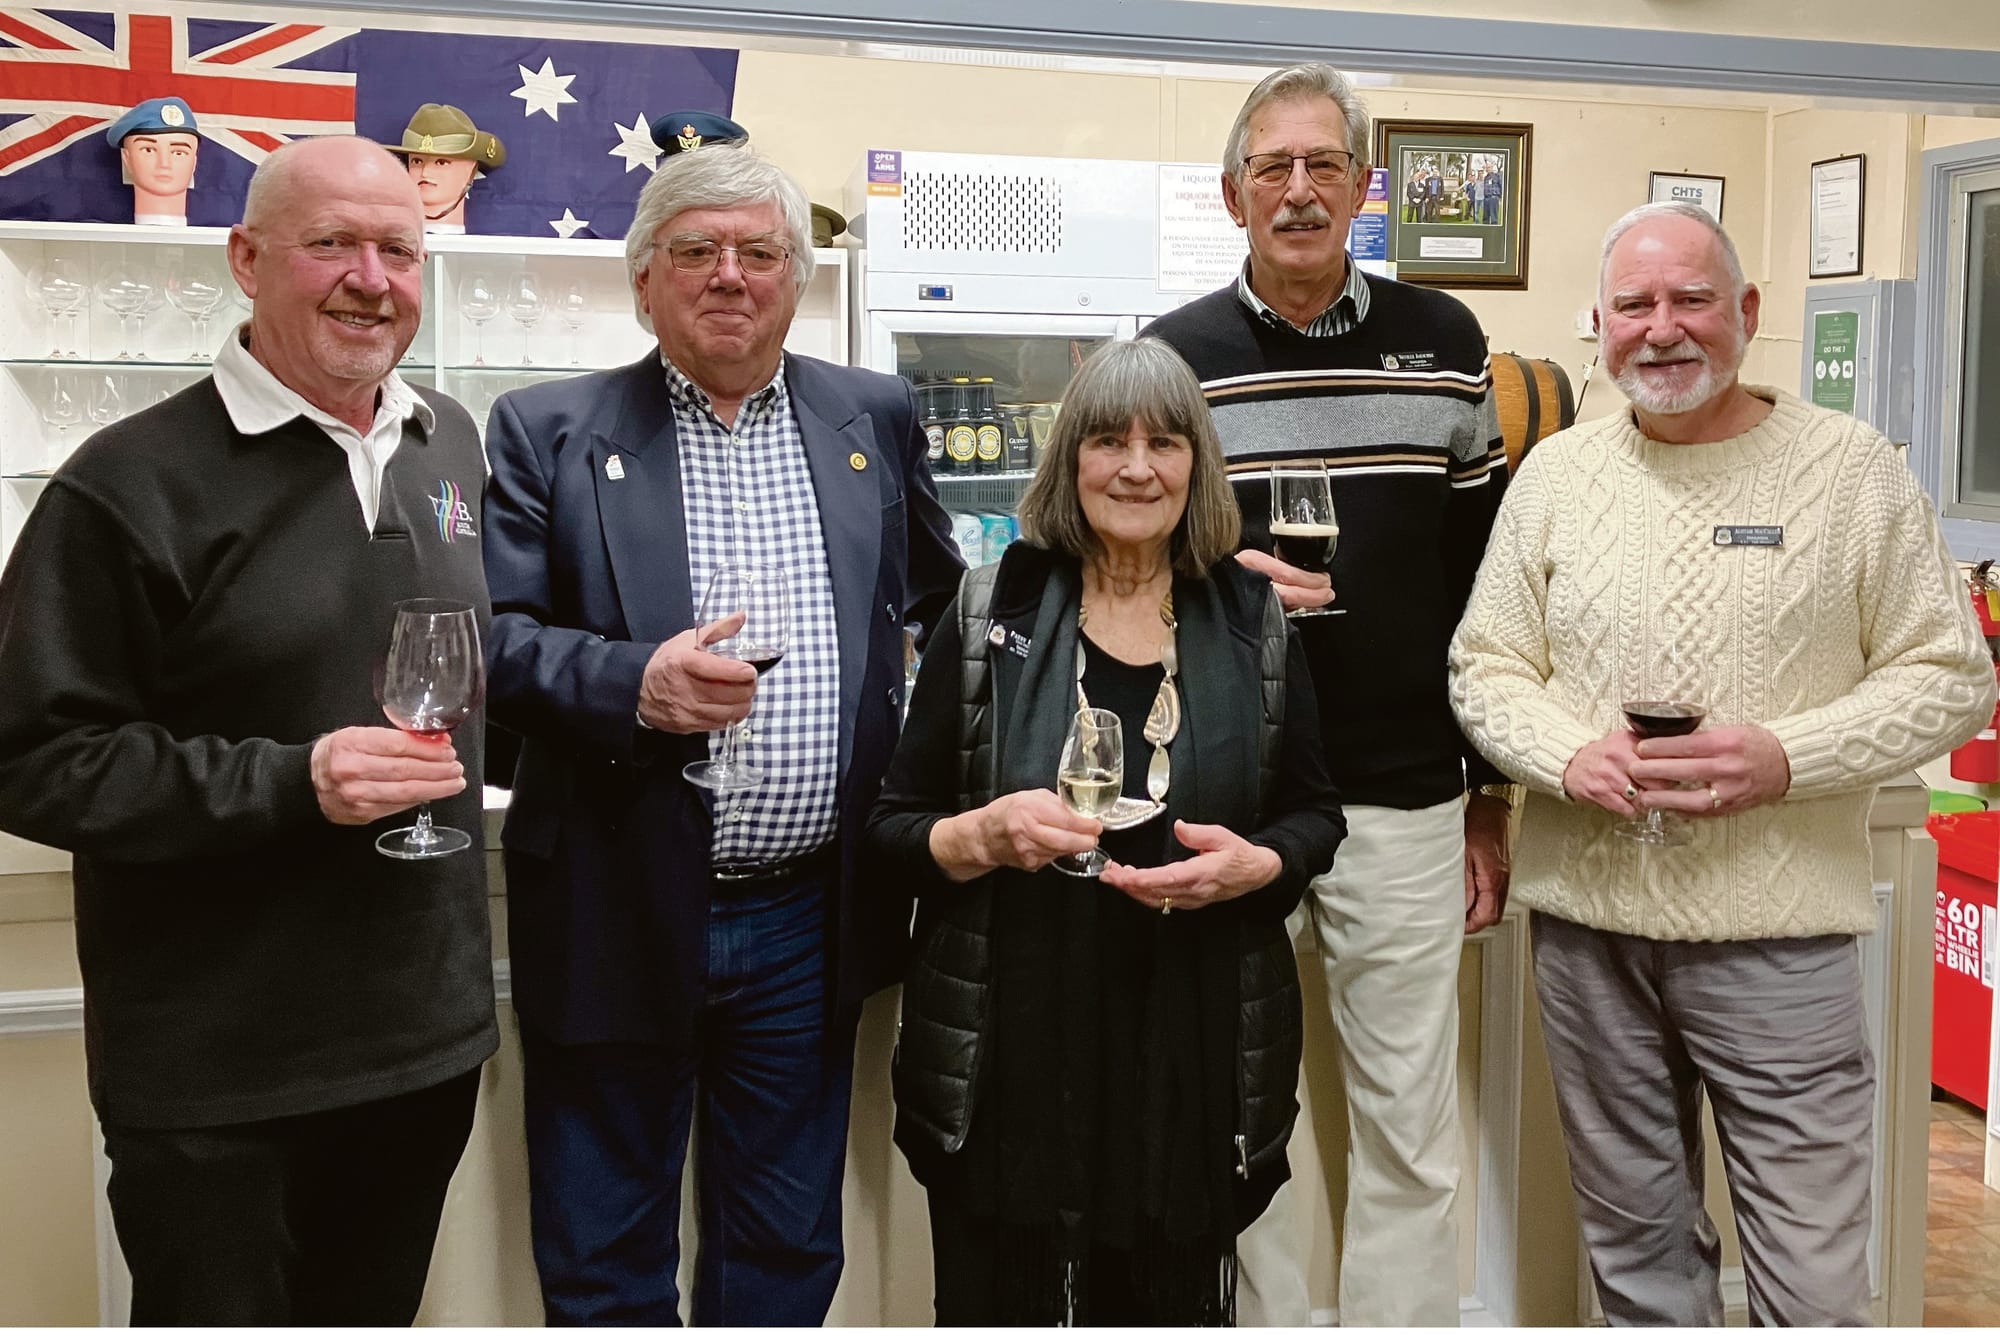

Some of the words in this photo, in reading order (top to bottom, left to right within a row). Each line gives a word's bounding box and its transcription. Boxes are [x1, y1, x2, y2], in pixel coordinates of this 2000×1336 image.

[874, 152, 895, 161] OPEN
[874, 163, 896, 172] ARMS
[1182, 175, 1217, 184] LIQUOR
[1175, 191, 1211, 201] LIQUOR
[1671, 186, 1703, 198] CHTS
[1947, 897, 1980, 930] 60
[1947, 920, 1979, 949] LTR
[1947, 939, 1979, 960] WHEELIE
[1946, 947, 1980, 980] BIN
